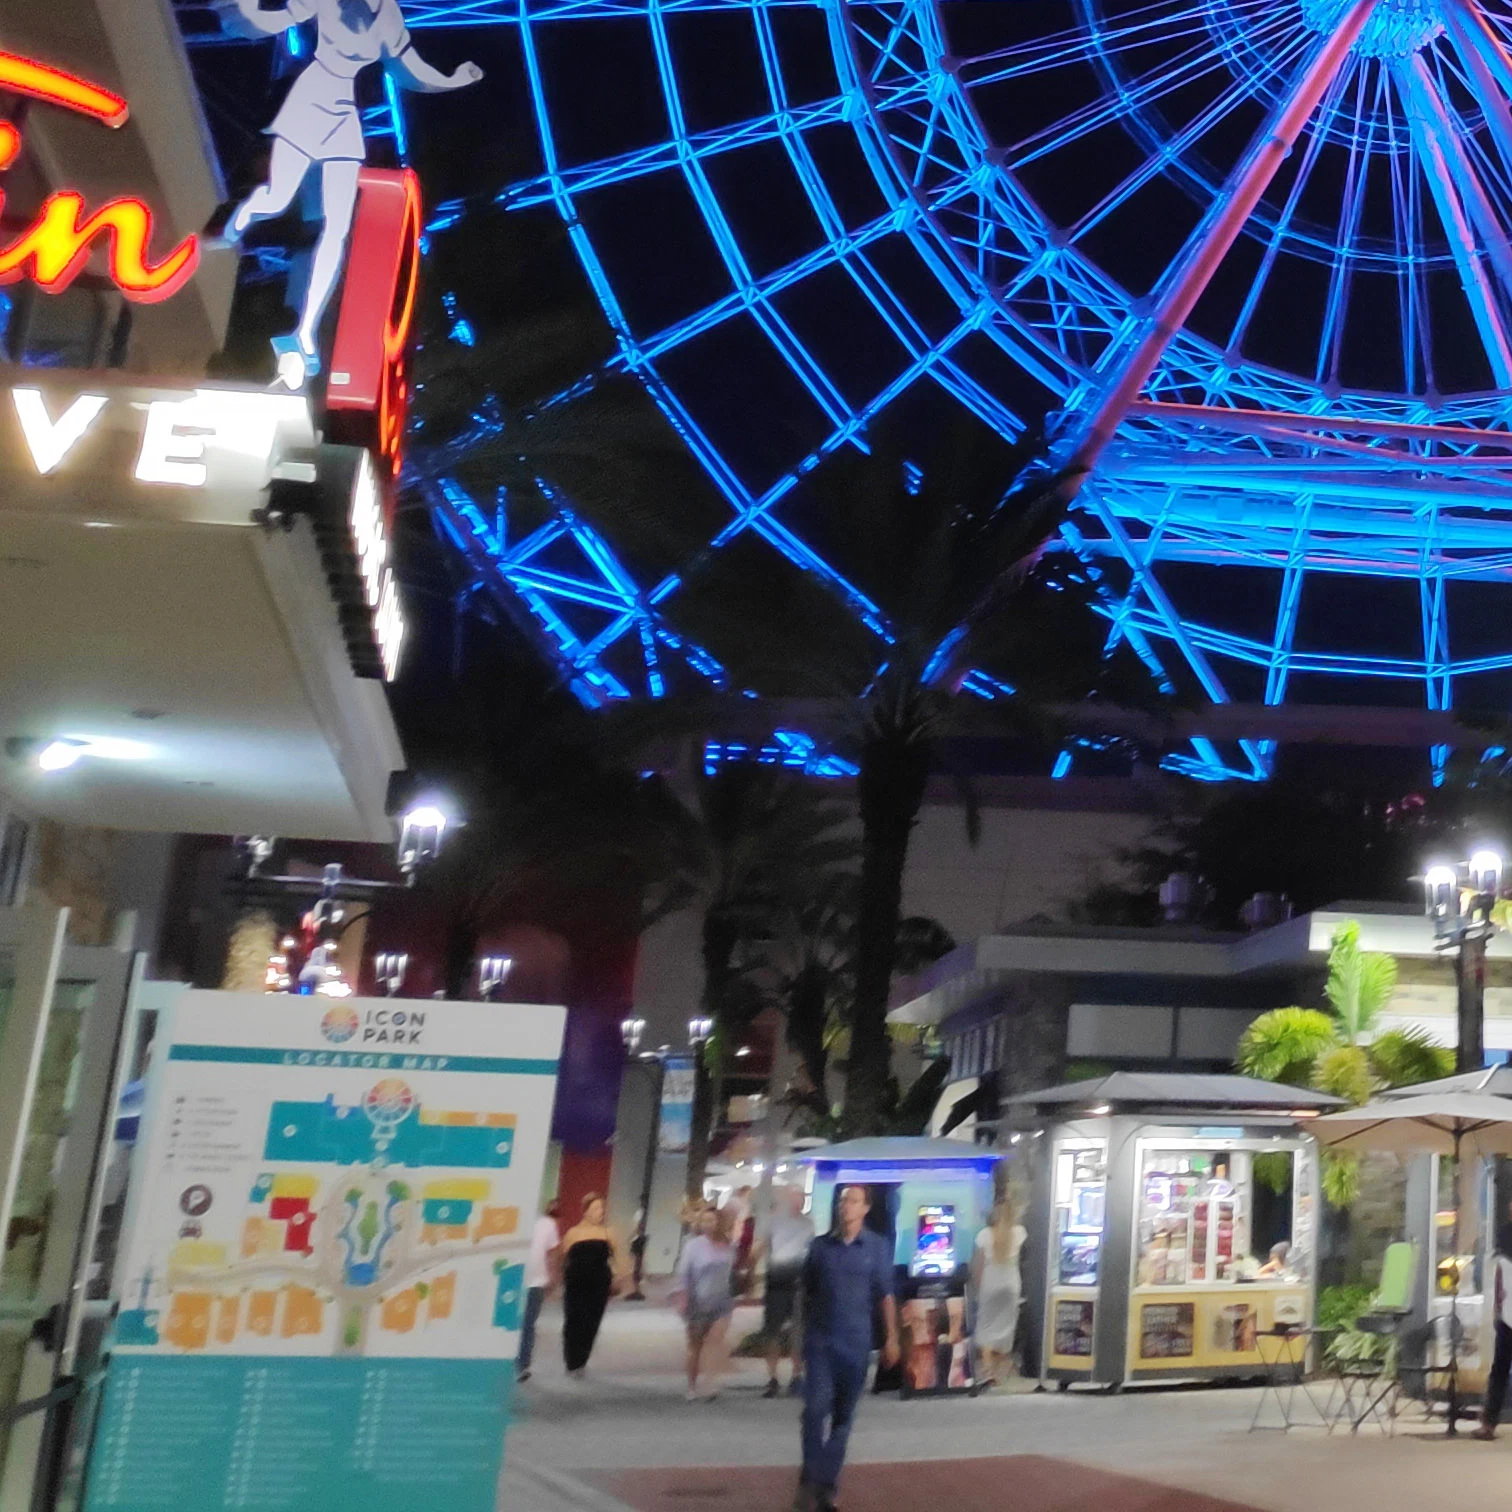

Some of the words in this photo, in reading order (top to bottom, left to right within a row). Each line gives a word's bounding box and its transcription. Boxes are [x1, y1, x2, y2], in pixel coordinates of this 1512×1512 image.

[0, 119, 200, 305] n
[365, 1010, 426, 1027] ICON
[363, 1028, 424, 1045] PARK
[282, 1052, 392, 1069] LOCATOR
[402, 1056, 450, 1071] MAP
